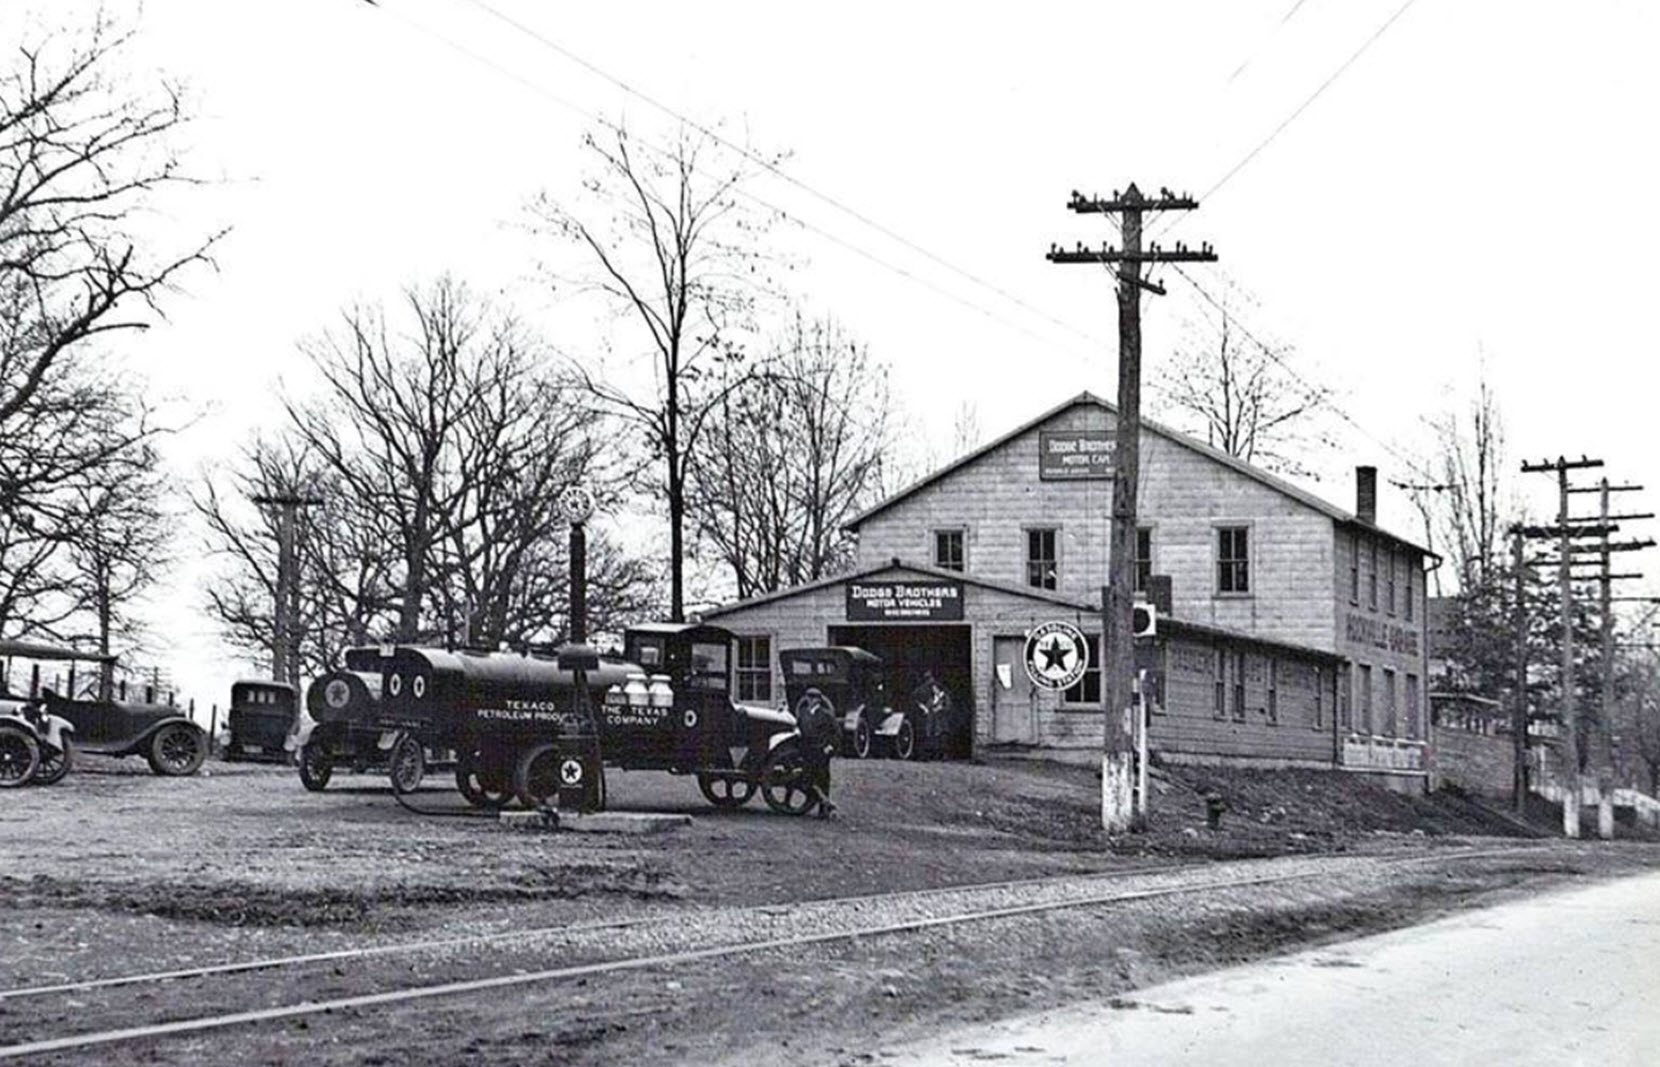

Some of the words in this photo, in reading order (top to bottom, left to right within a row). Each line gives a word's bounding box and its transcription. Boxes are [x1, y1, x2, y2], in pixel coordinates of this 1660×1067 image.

[1062, 455, 1090, 465] MOTOR
[852, 585, 893, 599] DODGE
[895, 585, 958, 599] BROTHERS
[866, 599, 896, 608] MOTOR
[898, 599, 942, 608] VEHICLES
[506, 700, 555, 711] TEXACO
[601, 705, 621, 715] THE
[631, 706, 668, 717] TEXAS
[477, 709, 533, 720] PETROLEUM
[606, 715, 659, 726] COMPANY
